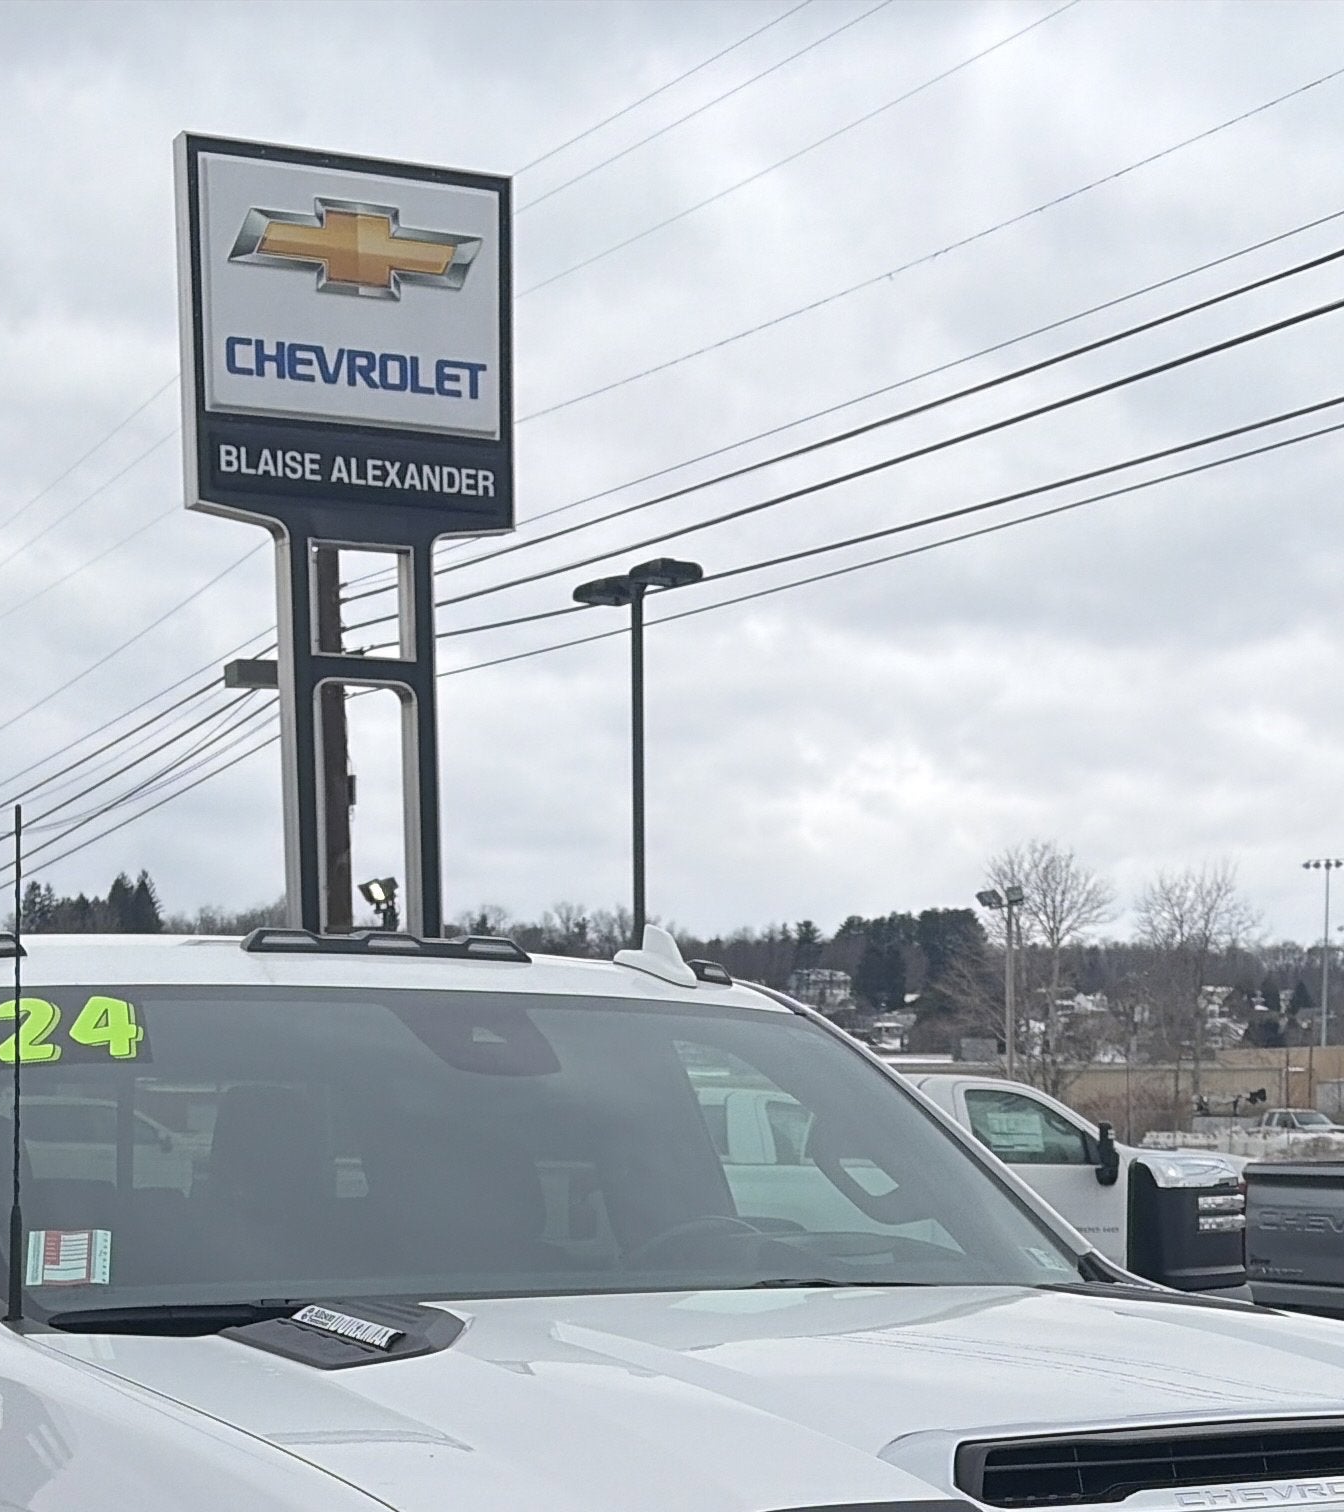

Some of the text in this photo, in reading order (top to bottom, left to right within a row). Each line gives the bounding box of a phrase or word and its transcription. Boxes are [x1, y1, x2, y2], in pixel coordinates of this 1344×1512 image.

[226, 336, 487, 400] CHEVROLET
[219, 444, 496, 497] BLAISE ALEXANDER
